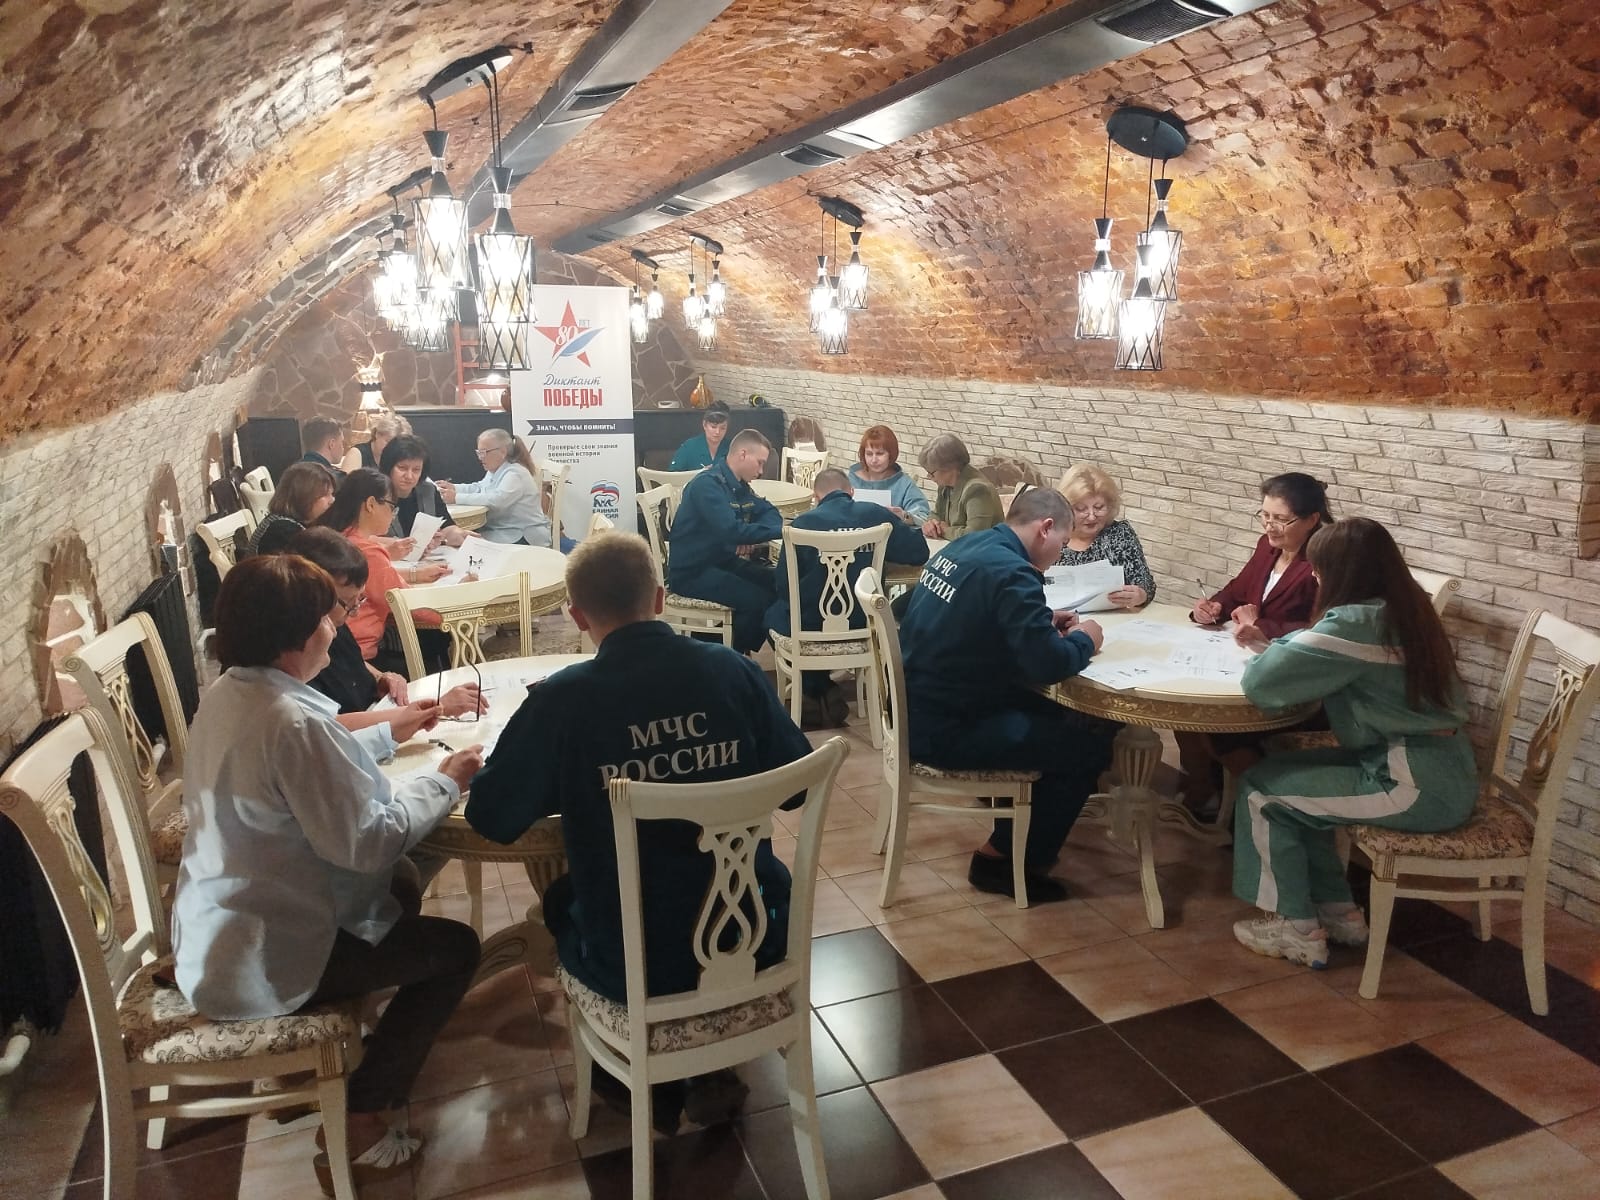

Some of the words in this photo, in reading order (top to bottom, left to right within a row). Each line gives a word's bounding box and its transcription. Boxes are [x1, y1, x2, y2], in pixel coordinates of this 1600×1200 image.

[555, 325, 578, 345] 80
[543, 373, 602, 386] Диктант
[543, 388, 603, 409] ПОБЕДЫ
[931, 555, 958, 577] МЧС
[920, 568, 957, 603] ОССИИ
[628, 712, 708, 750] МЧС
[598, 739, 741, 790] РОССИИ
